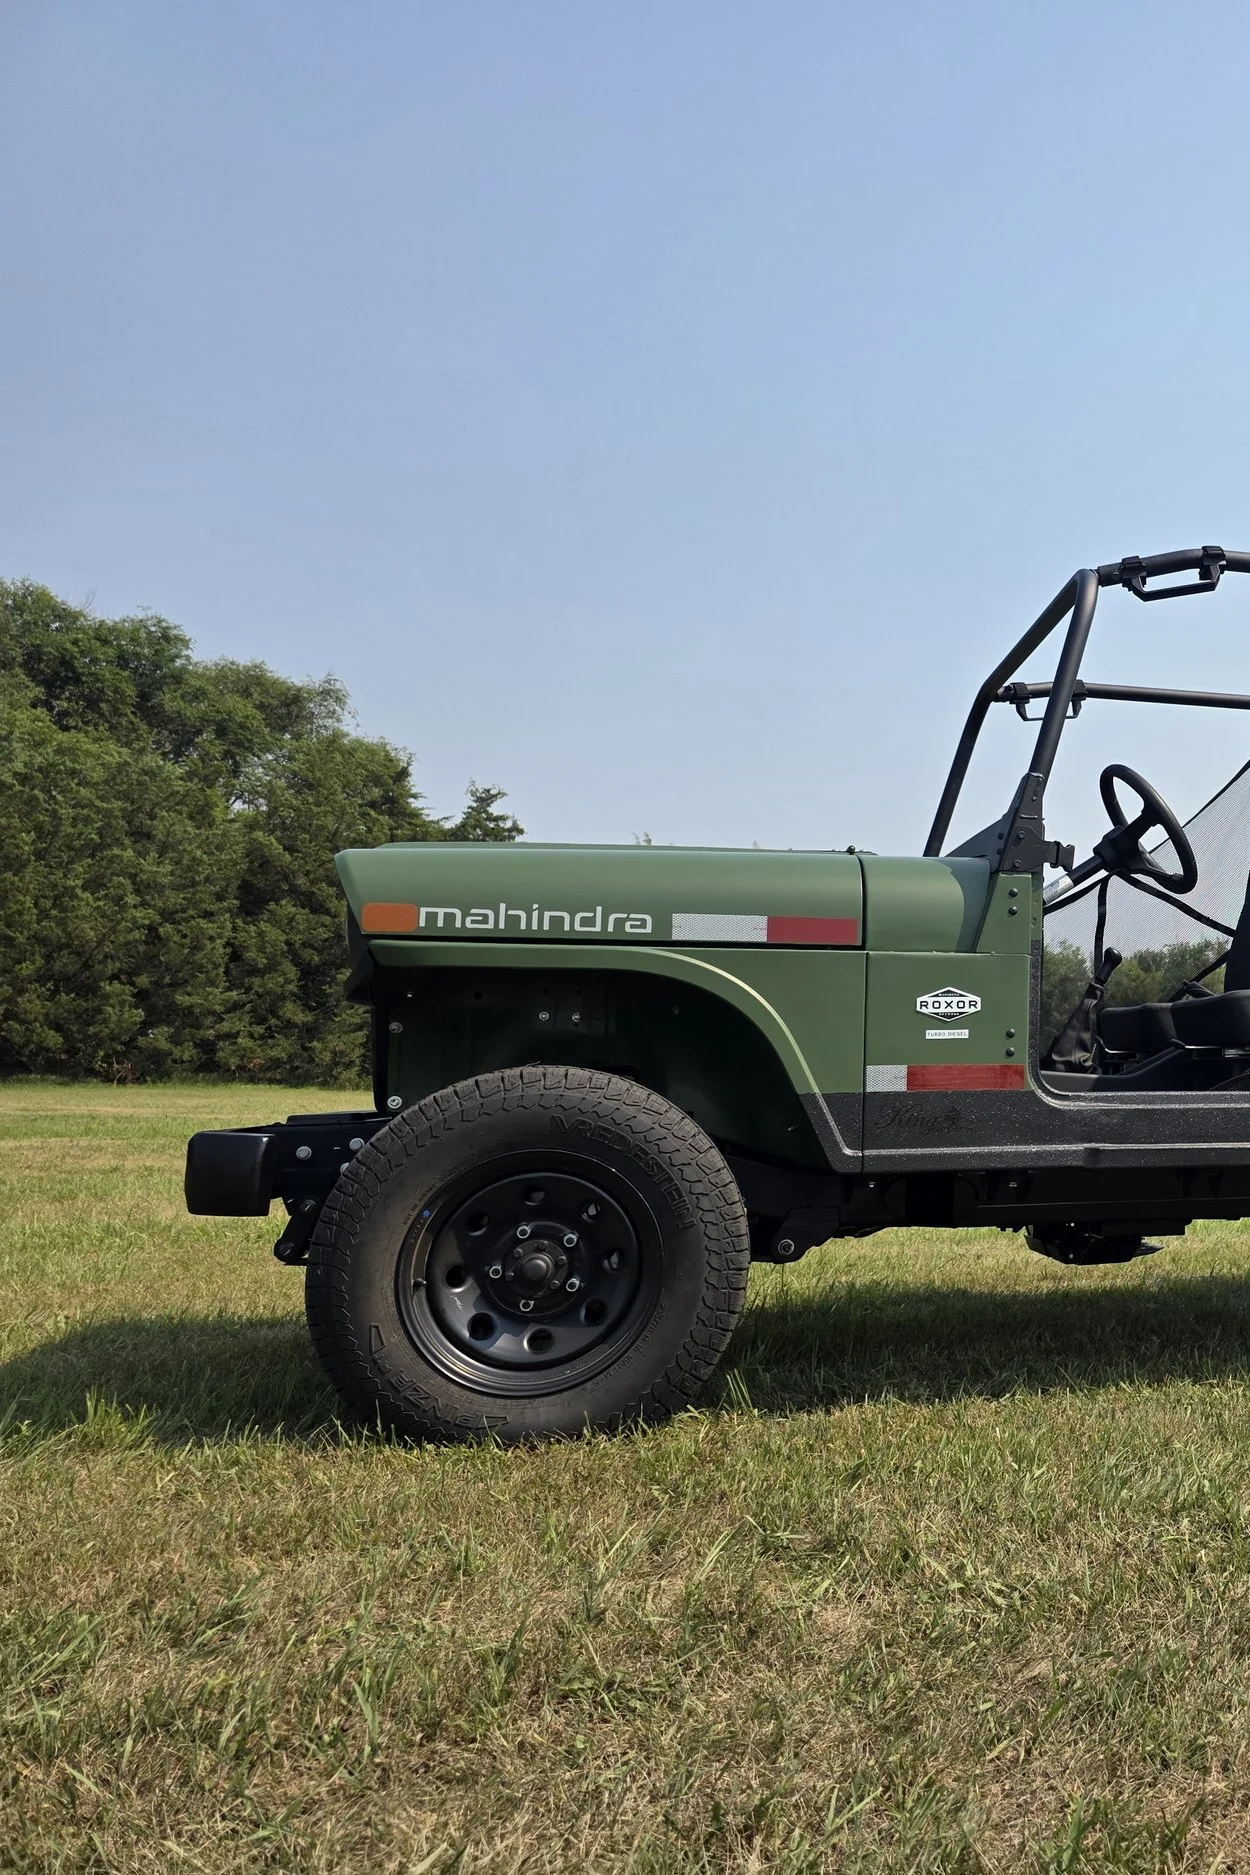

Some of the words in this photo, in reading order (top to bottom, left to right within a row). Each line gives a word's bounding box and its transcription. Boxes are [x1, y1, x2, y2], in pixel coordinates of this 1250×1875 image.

[419, 902, 653, 934] mahindra
[919, 1000, 978, 1010] ROXOR
[551, 1113, 697, 1229] VREDESTEIN
[388, 1369, 480, 1430] PINZA
